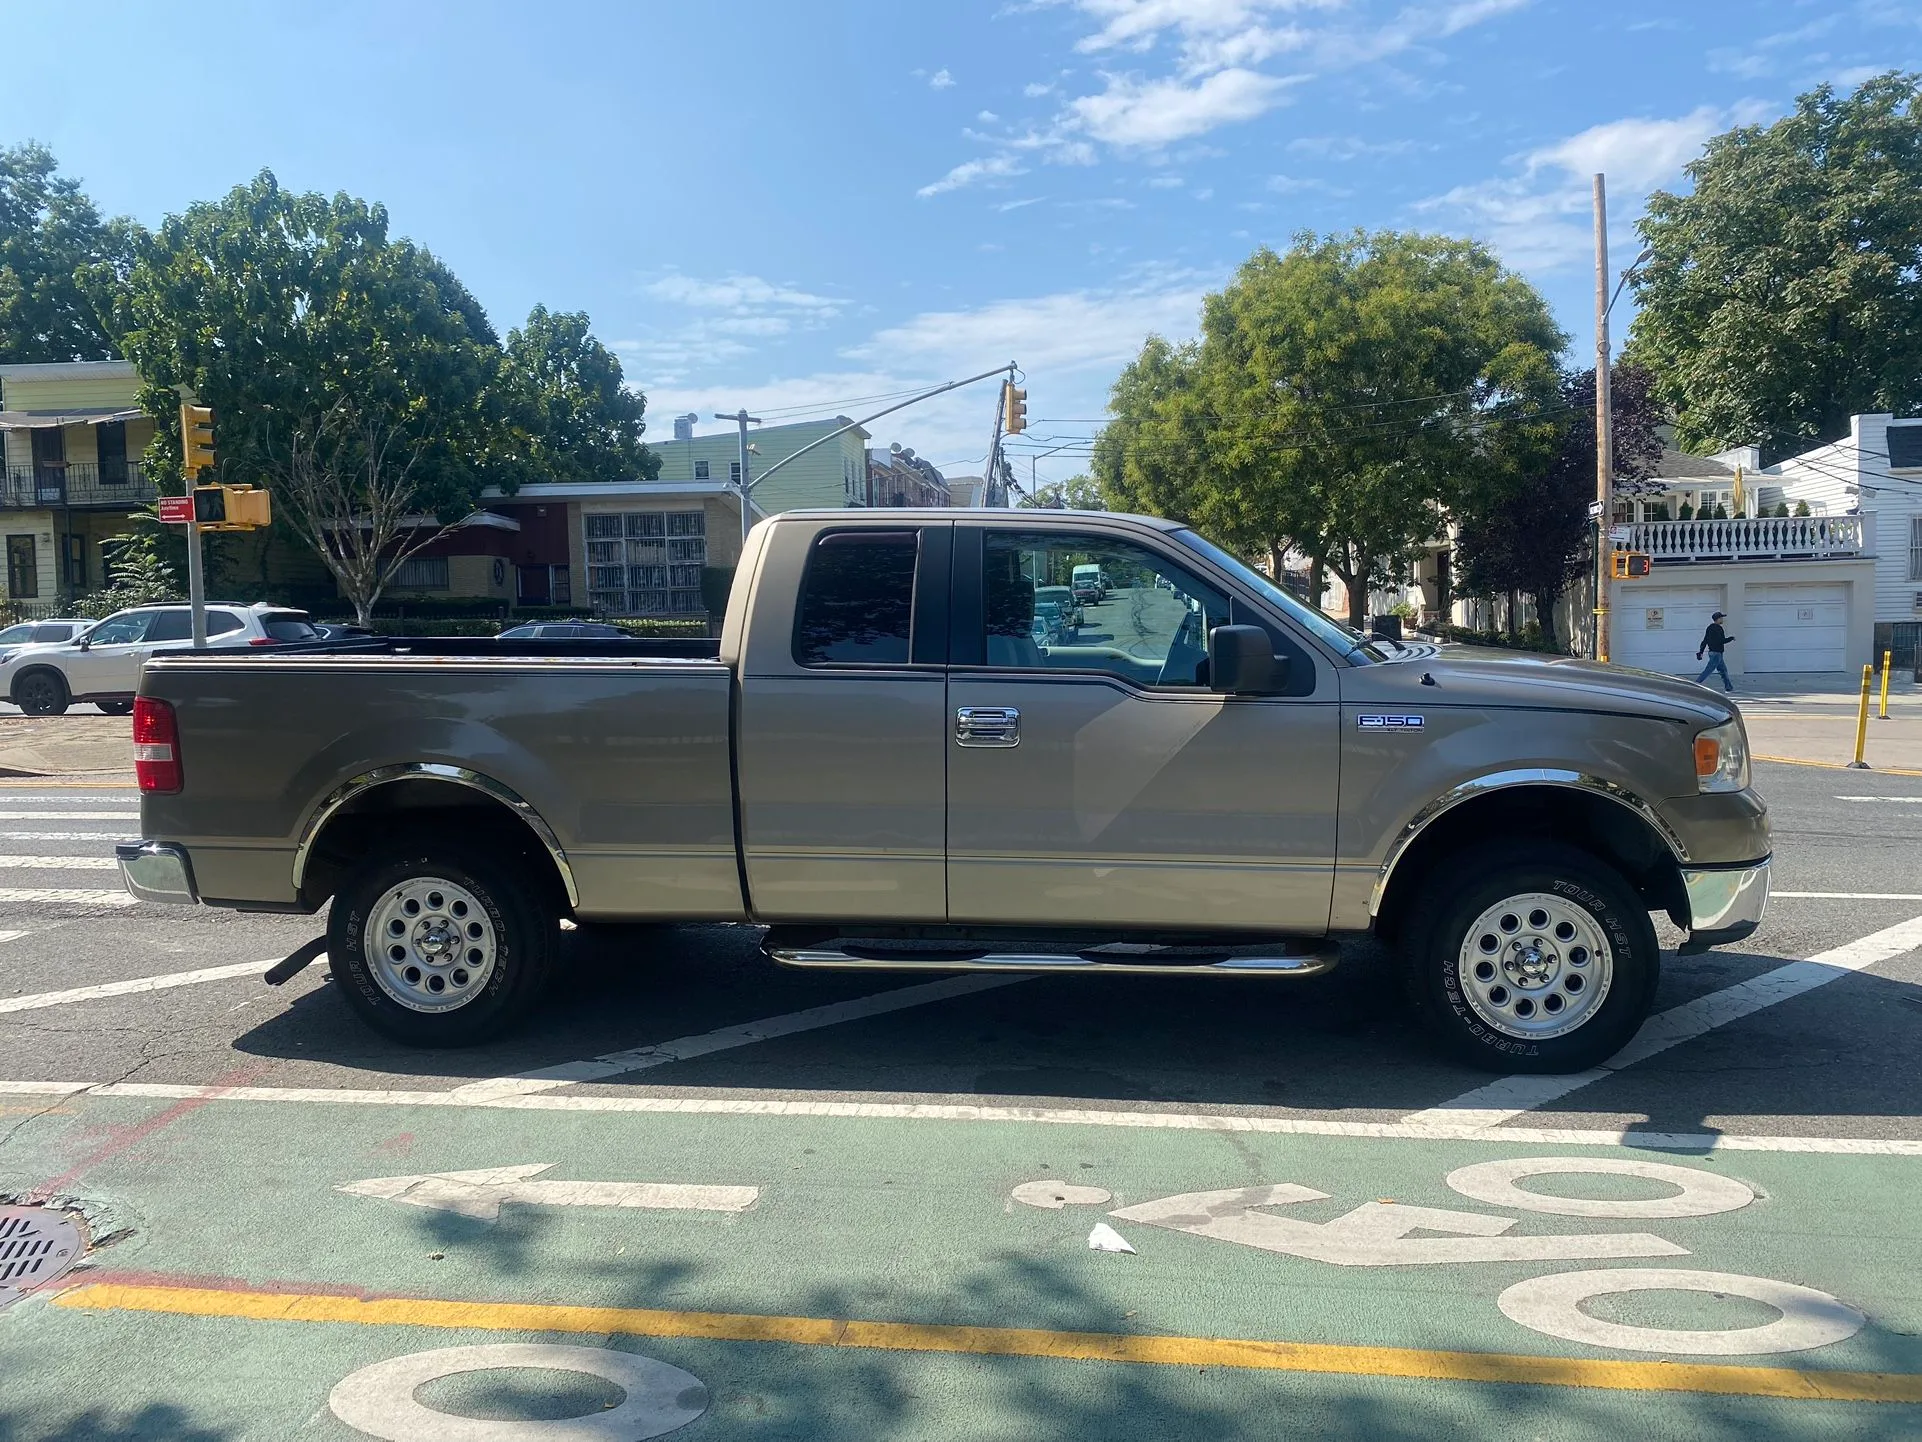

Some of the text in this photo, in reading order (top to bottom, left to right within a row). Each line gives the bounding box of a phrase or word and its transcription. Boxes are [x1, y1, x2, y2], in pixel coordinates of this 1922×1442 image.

[1643, 559, 1649, 573] 3
[345, 909, 363, 952] HST
[1552, 879, 1632, 959] TOUR HST
